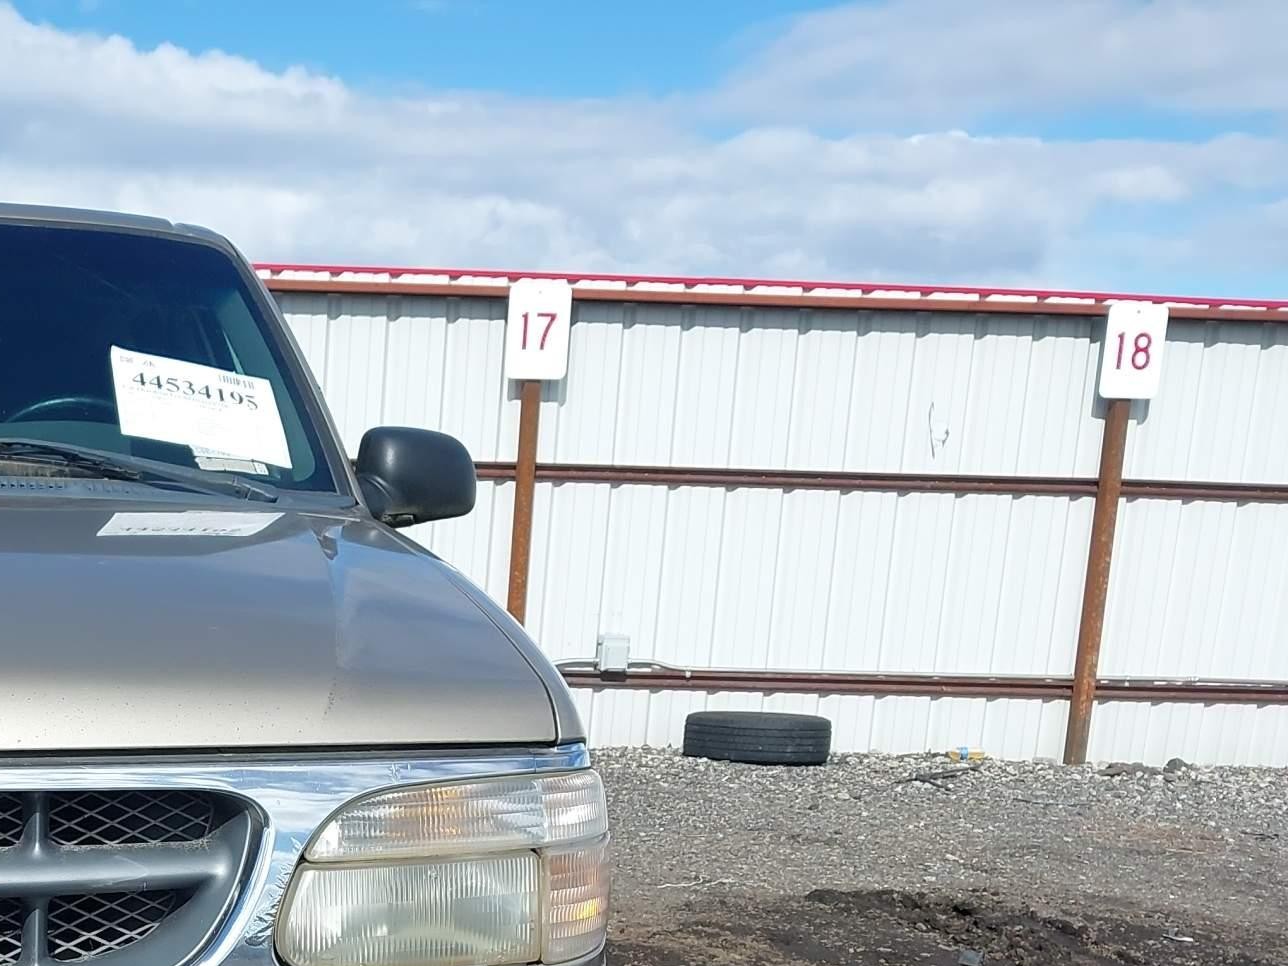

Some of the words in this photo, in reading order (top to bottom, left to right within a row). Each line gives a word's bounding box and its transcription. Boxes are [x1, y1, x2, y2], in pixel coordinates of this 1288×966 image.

[521, 311, 558, 350] 17
[1115, 331, 1152, 370] 18
[132, 371, 259, 411] 44534195
